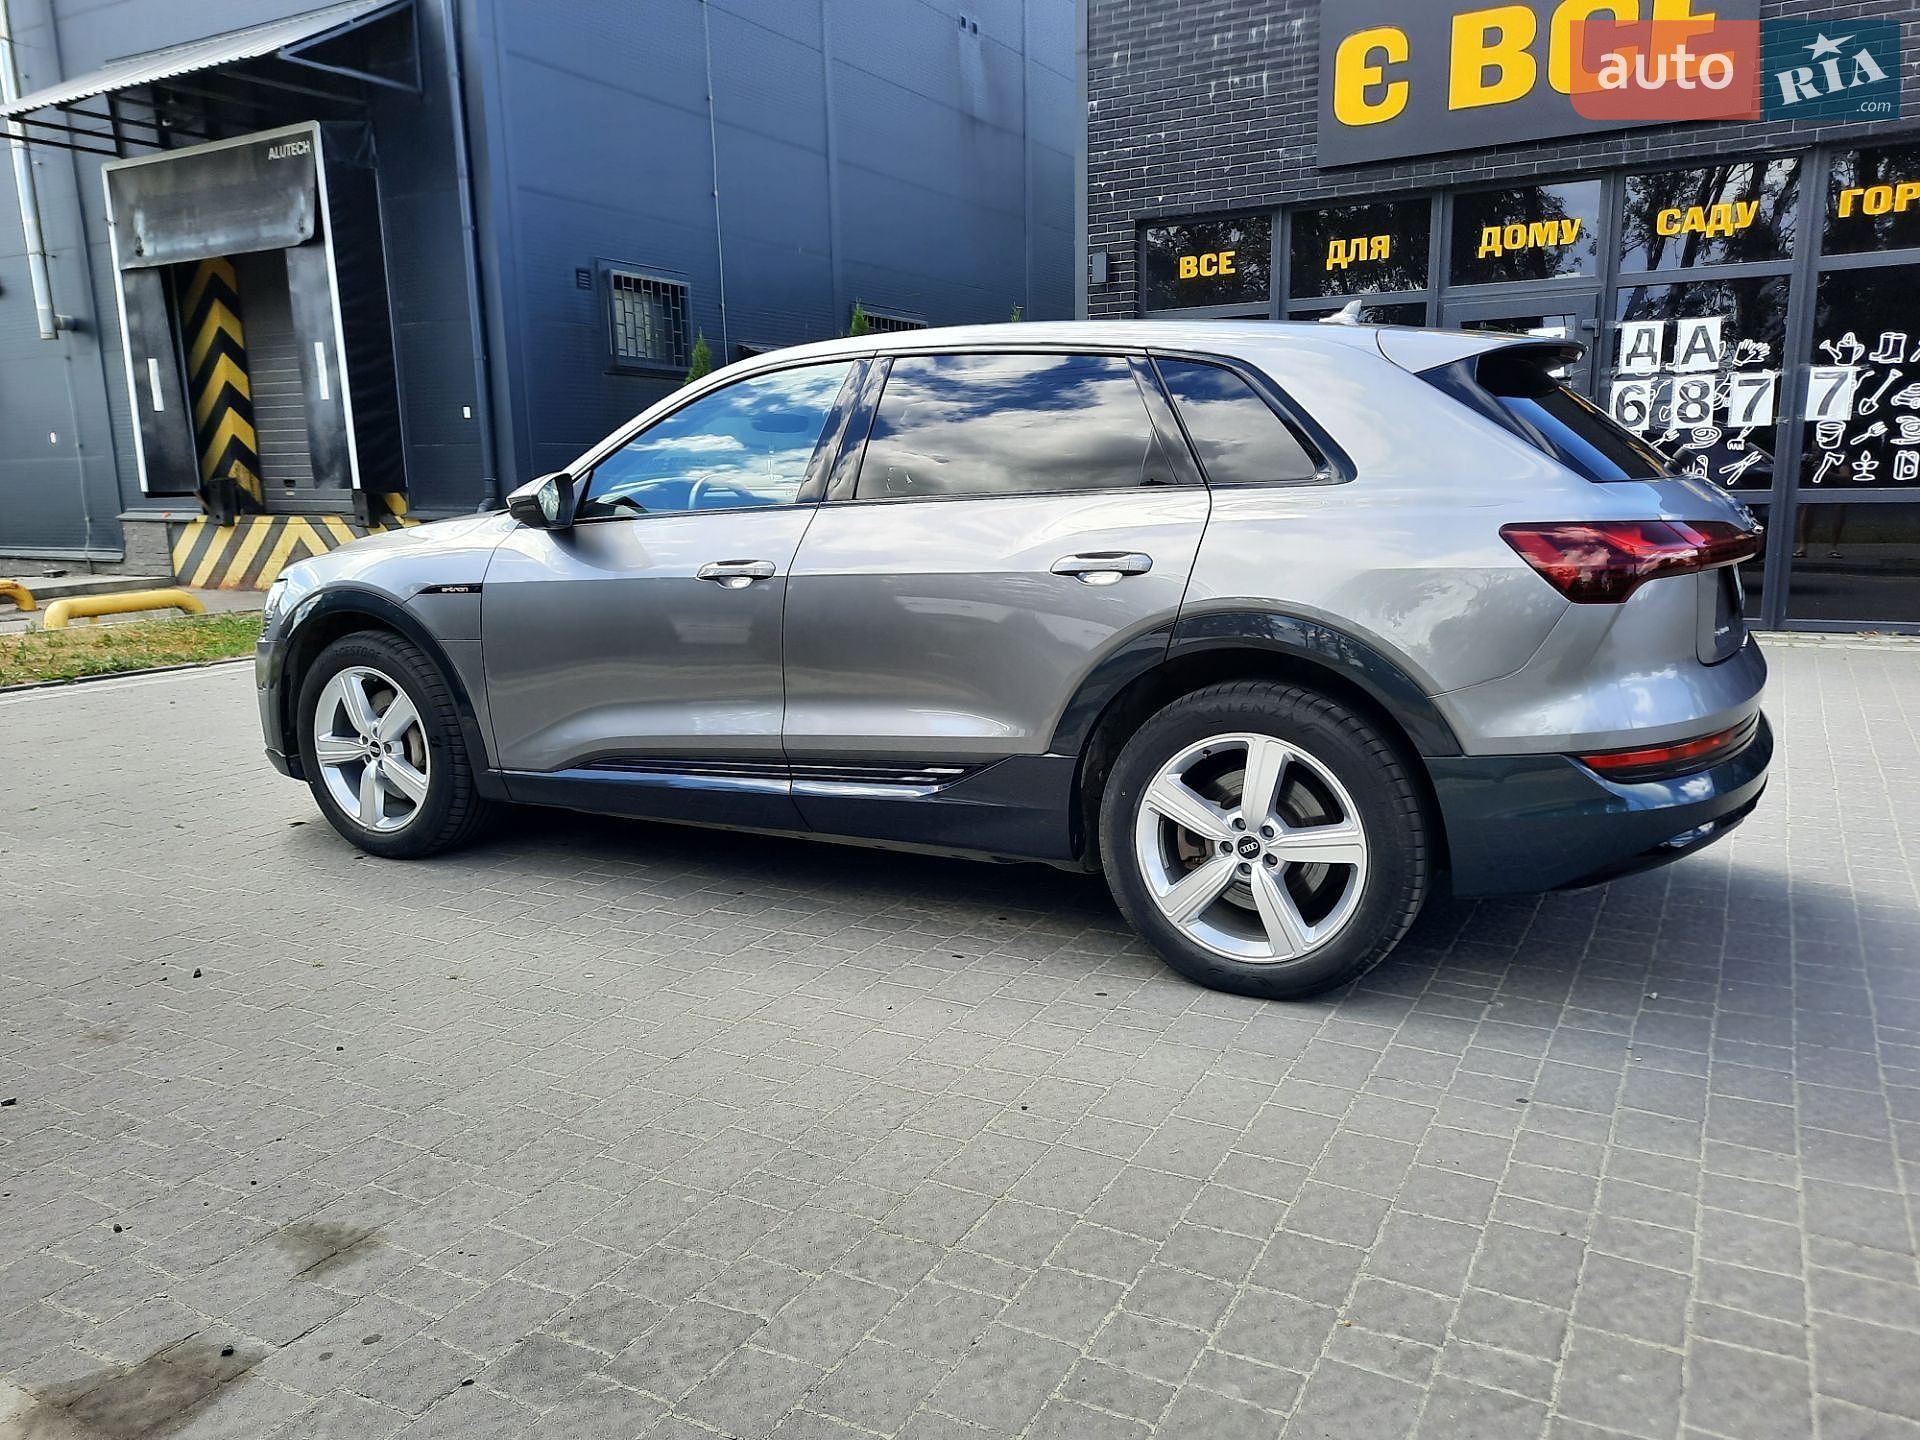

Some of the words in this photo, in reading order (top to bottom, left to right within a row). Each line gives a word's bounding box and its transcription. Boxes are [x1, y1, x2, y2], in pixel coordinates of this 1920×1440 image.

[1333, 26, 1410, 127] Є
[1447, 0, 1735, 111] ВСЕ
[267, 140, 311, 161] ALUTECH
[1178, 250, 1237, 280] ВСЕ
[1325, 234, 1392, 271] ДЛЯ
[1476, 217, 1583, 260] ДОМУ
[1655, 199, 1760, 239] САДУ
[1837, 182, 1920, 218] ГОР
